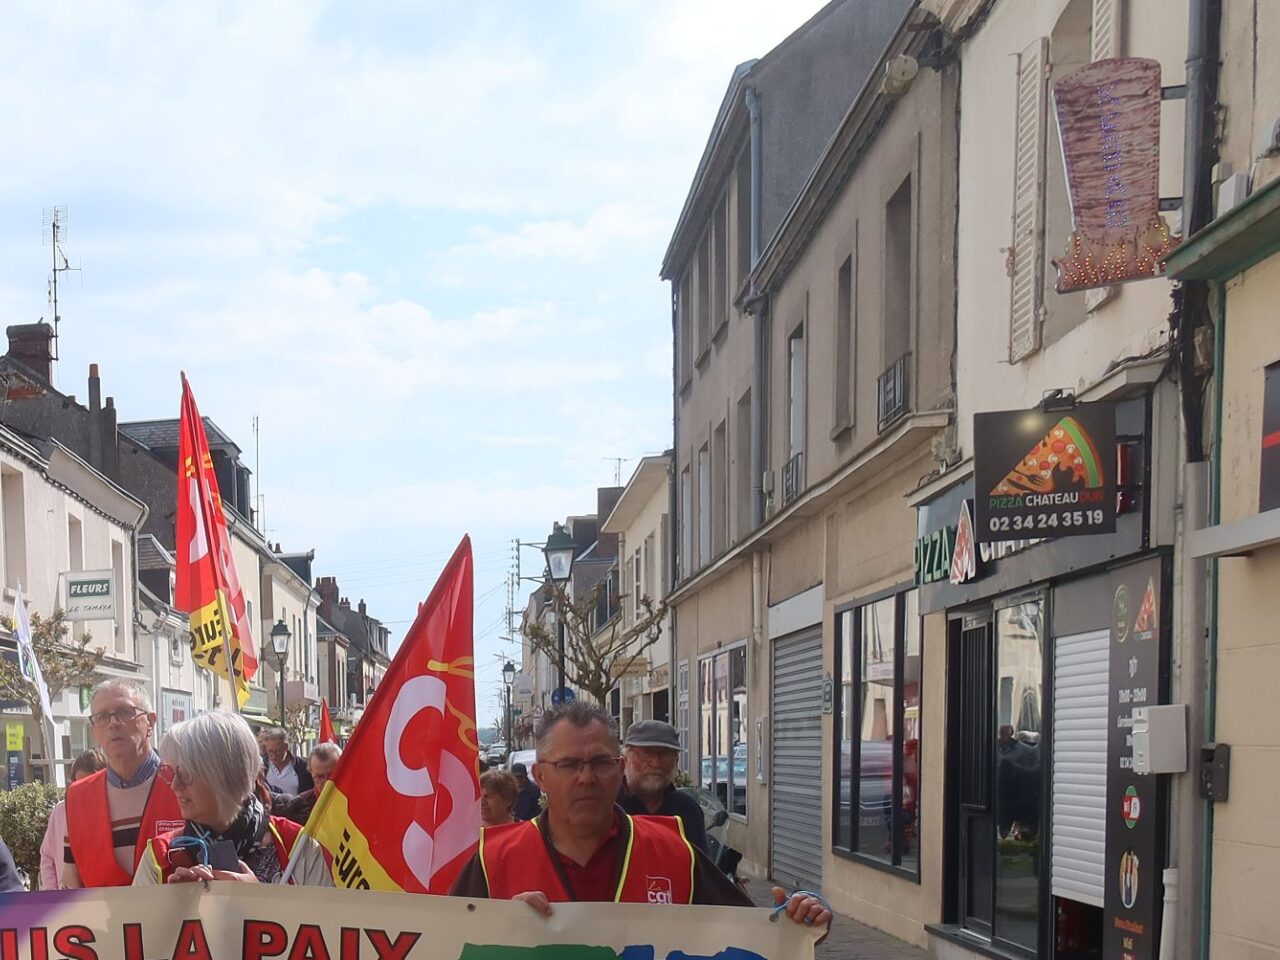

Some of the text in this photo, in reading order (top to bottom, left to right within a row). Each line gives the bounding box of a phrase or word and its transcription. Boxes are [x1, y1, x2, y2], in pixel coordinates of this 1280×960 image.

[1097, 81, 1128, 228] KEBAB
[989, 496, 1023, 509] PIZZA
[989, 509, 1104, 532] 02 34 24 35 19
[913, 526, 953, 585] PIZZA
[70, 583, 109, 595] FLEURS
